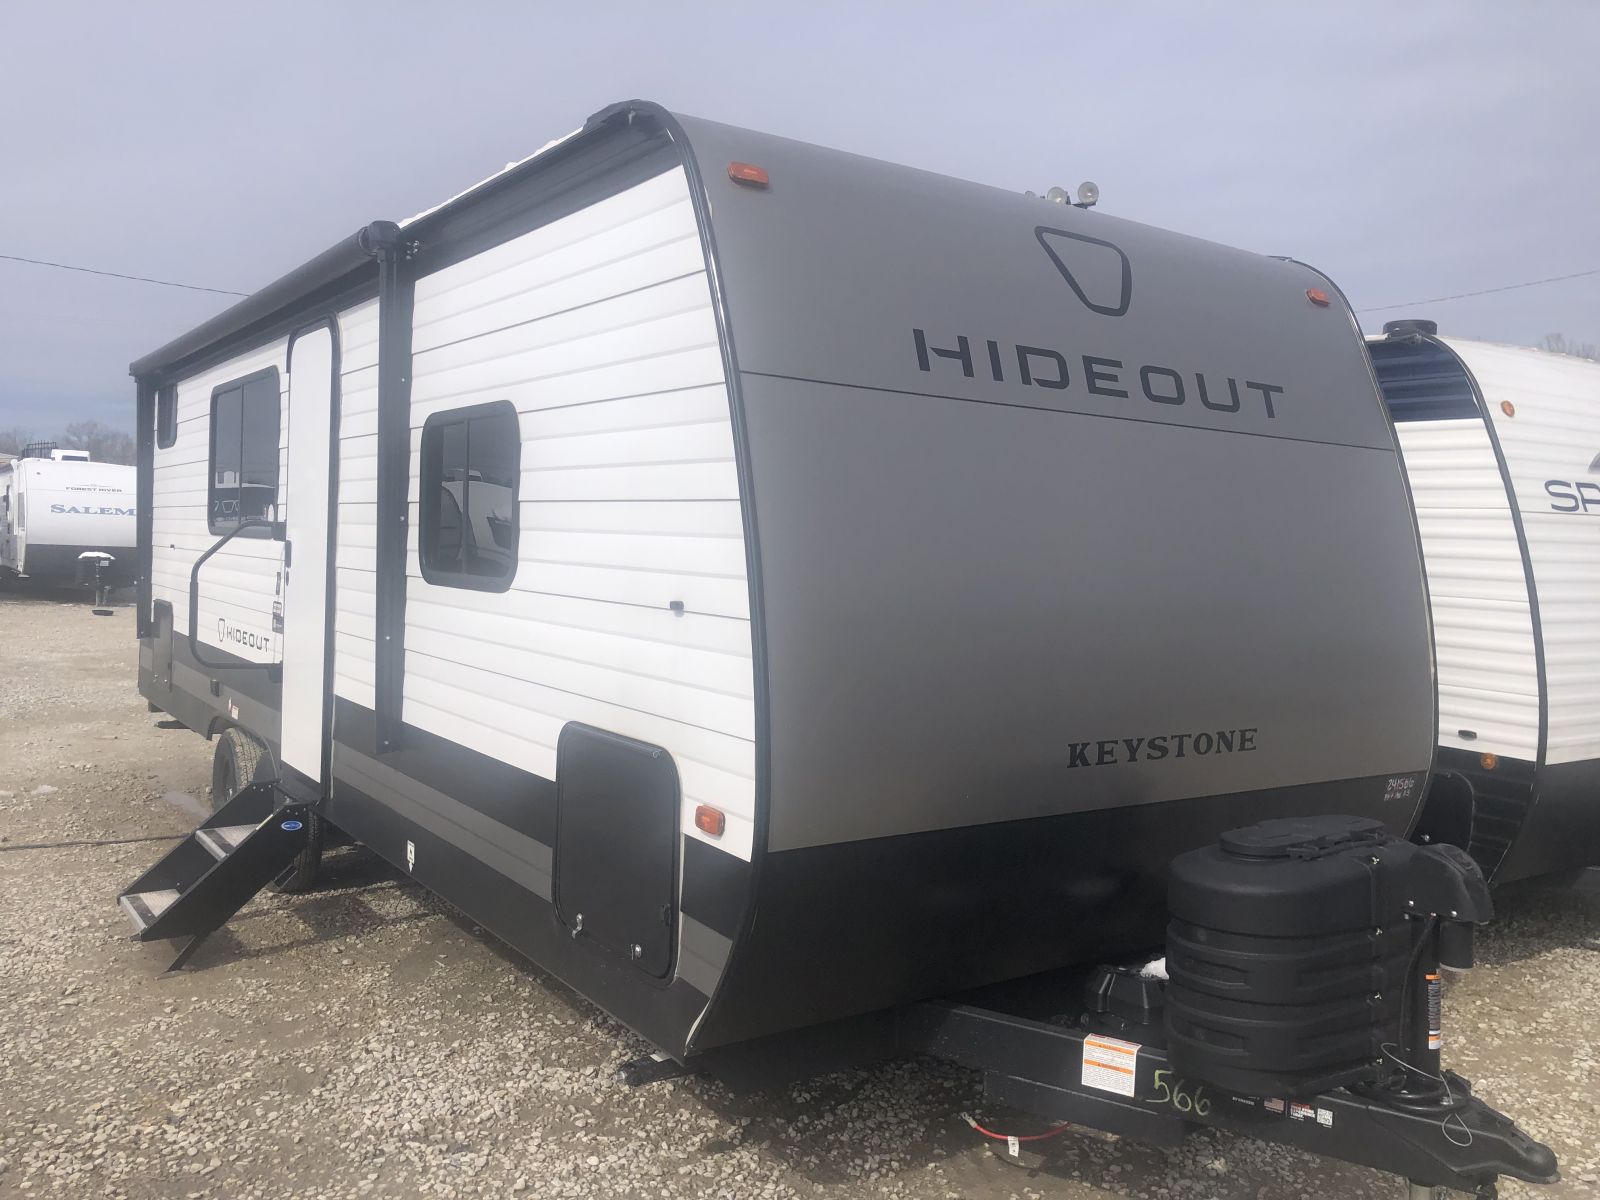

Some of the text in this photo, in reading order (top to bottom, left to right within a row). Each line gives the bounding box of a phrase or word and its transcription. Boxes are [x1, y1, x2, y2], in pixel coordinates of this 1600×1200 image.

[912, 328, 1284, 419] HIDEOUT
[50, 503, 136, 516] SALEM
[227, 626, 270, 652] HIDEOUT
[1067, 728, 1258, 768] KEYSTONE
[1145, 1069, 1211, 1116] 566
